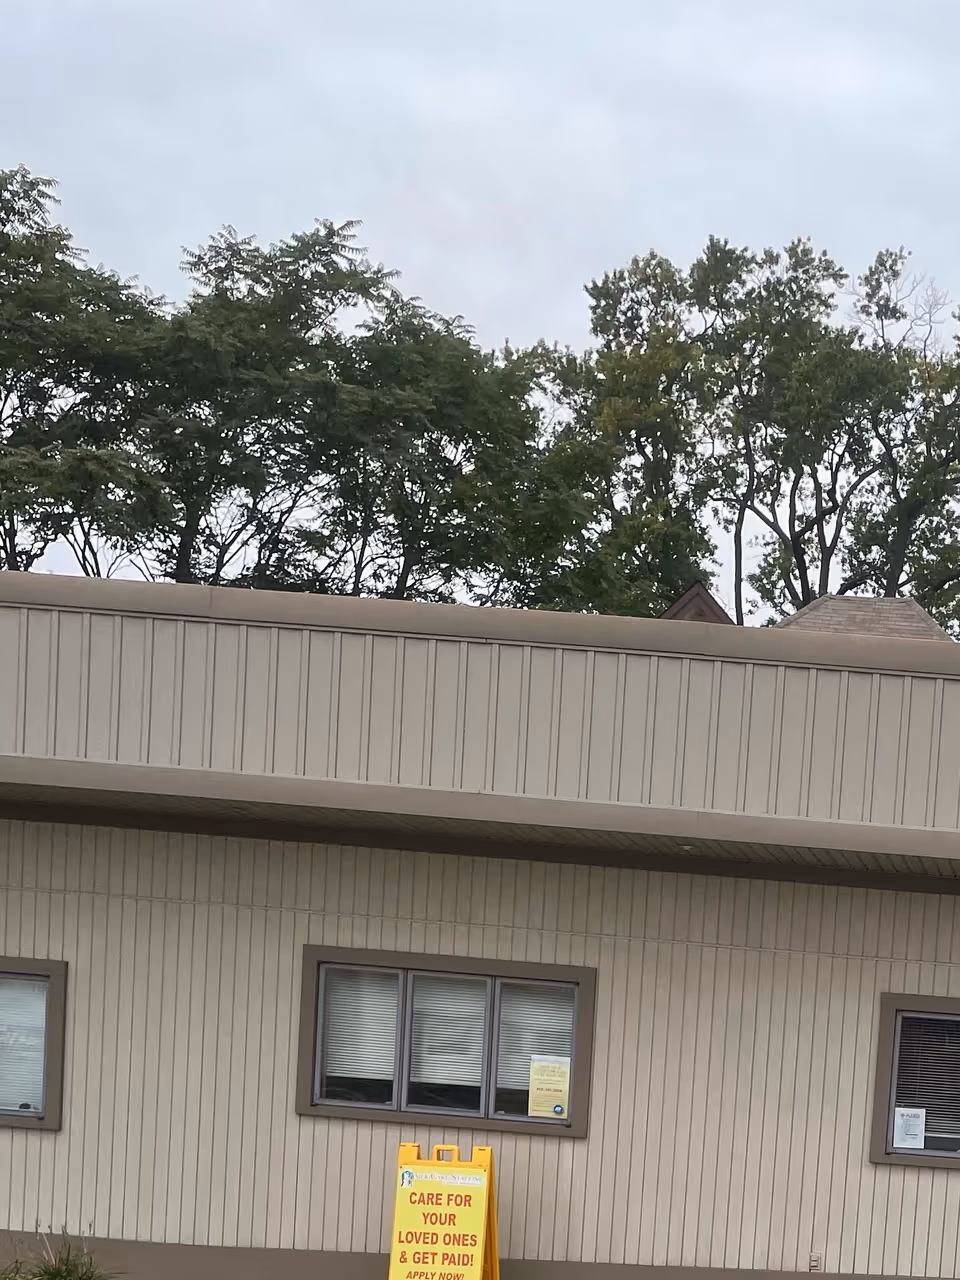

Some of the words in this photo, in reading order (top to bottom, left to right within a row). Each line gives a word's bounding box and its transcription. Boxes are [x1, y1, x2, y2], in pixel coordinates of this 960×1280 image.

[409, 1192, 443, 1206] CARE
[447, 1193, 472, 1207] FOR
[422, 1212, 457, 1226] YOUR
[398, 1230, 439, 1245] LOVED
[442, 1233, 478, 1247] ONES
[399, 1250, 408, 1263] &
[412, 1251, 438, 1265] GET
[441, 1252, 474, 1267] PAID!
[405, 1271, 437, 1280] APPLY
